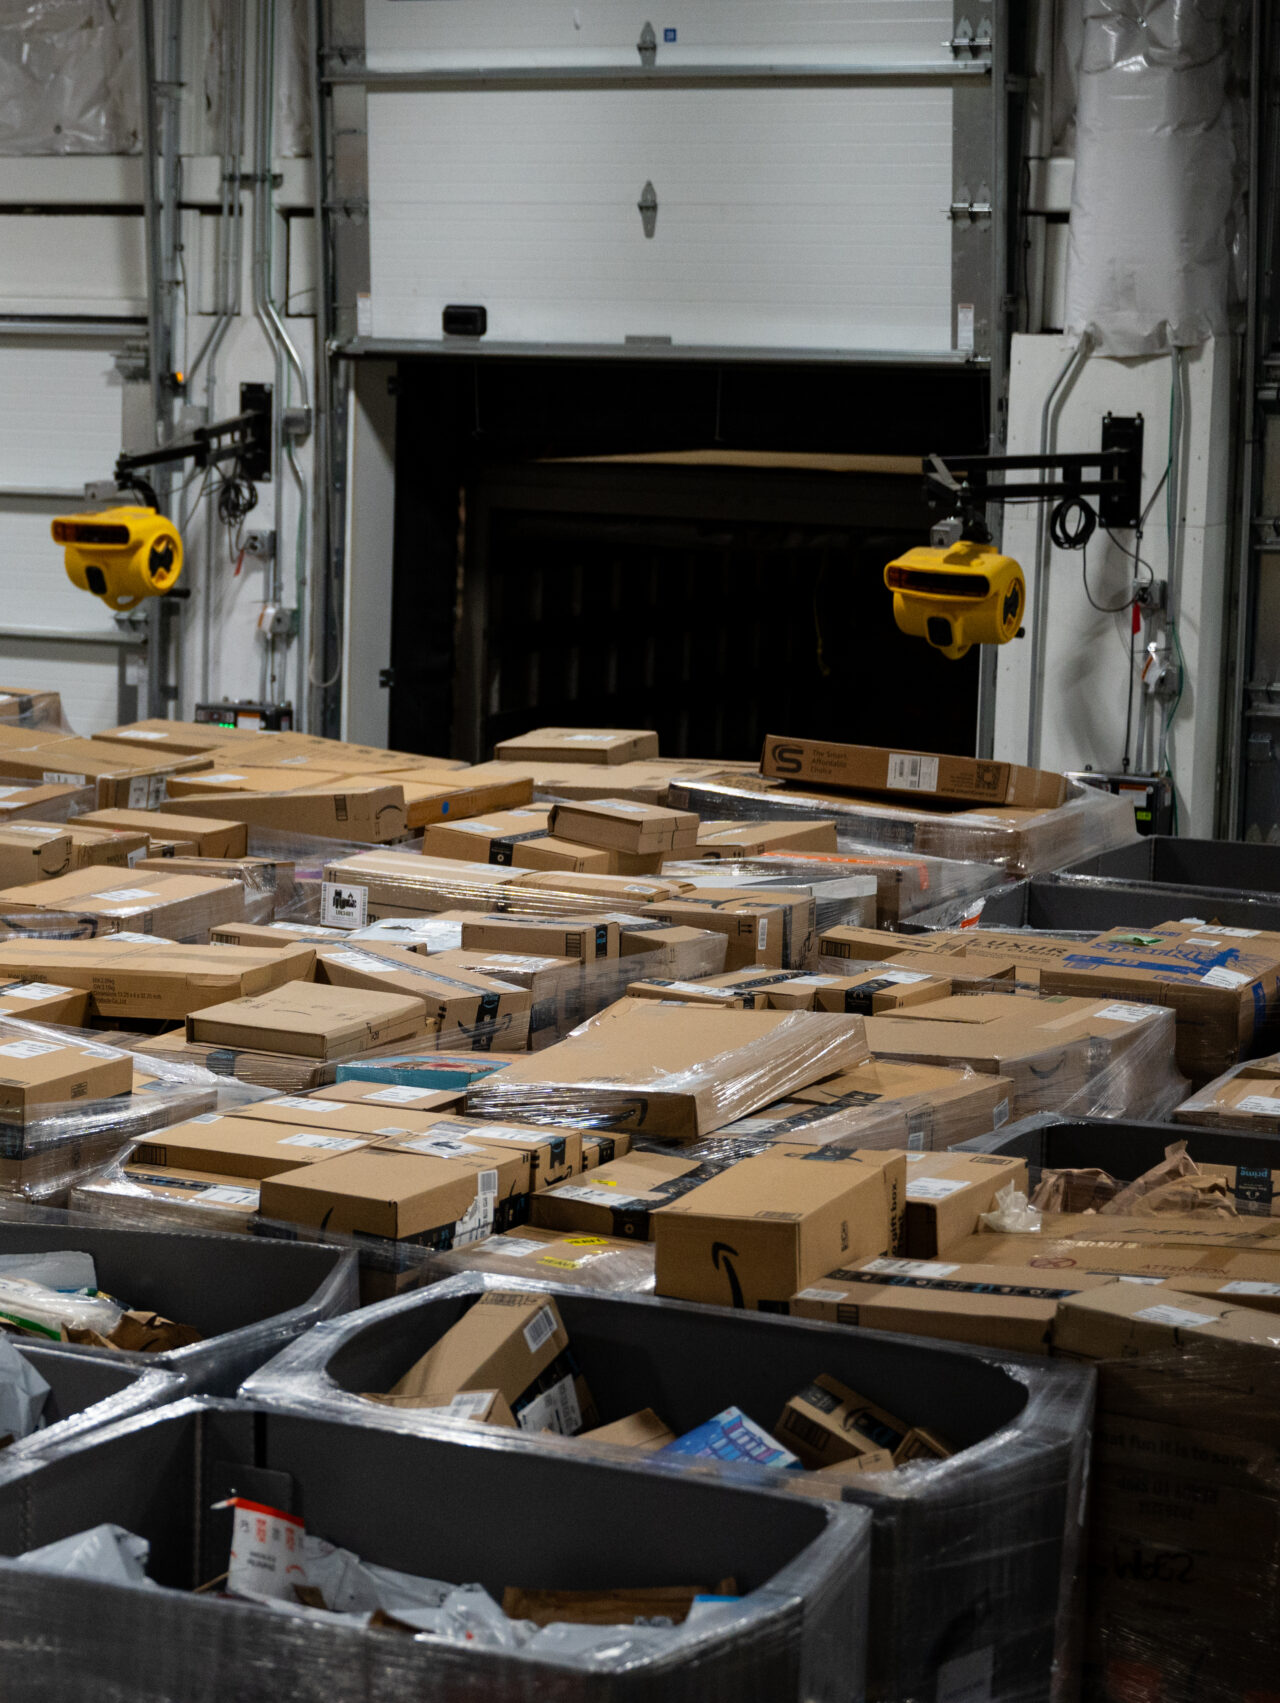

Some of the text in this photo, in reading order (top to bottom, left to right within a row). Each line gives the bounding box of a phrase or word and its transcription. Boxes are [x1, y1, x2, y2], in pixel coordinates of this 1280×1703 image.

[812, 749, 848, 760] The Smart
[811, 758, 848, 769] Affordable
[1239, 1167, 1268, 1179] prime
[1140, 1264, 1231, 1275] ATTENTION
[1192, 1444, 1209, 1461] to
